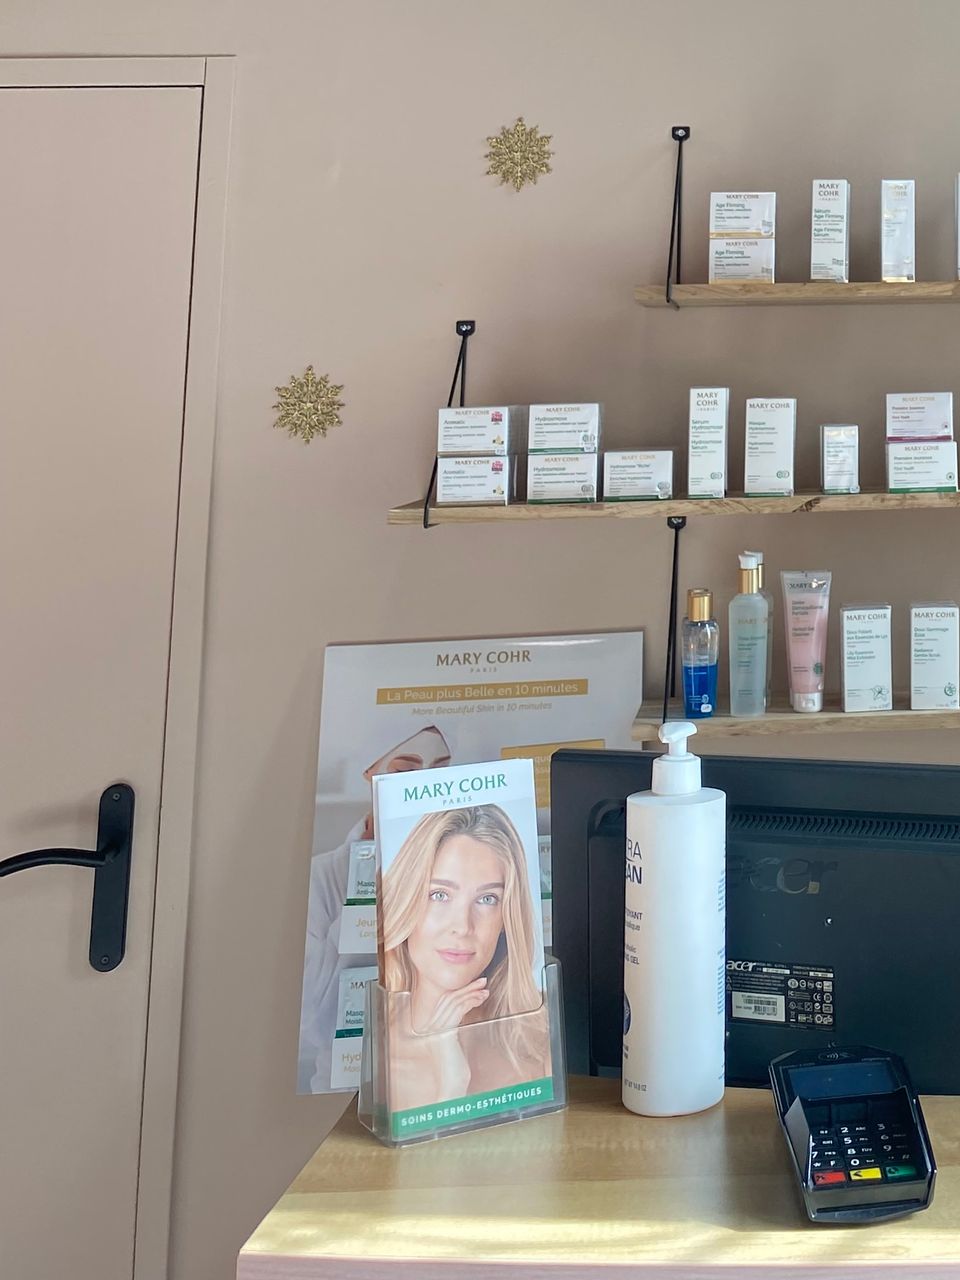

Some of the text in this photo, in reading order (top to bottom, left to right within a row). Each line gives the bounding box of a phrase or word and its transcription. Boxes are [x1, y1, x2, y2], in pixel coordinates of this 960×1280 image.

[436, 649, 532, 667] MARY COHR
[386, 682, 579, 702] La Peau plus Belle en 10 minutes
[412, 701, 553, 717] More Beautiful Skin in 10 minutes
[403, 773, 508, 802] MARY COHR
[442, 795, 473, 806] PARIS
[626, 838, 643, 861] RA
[726, 960, 757, 972] acer
[401, 1086, 543, 1128] SOINS DERMO-ESTHÉTIQUES
[844, 1137, 853, 1145] 5
